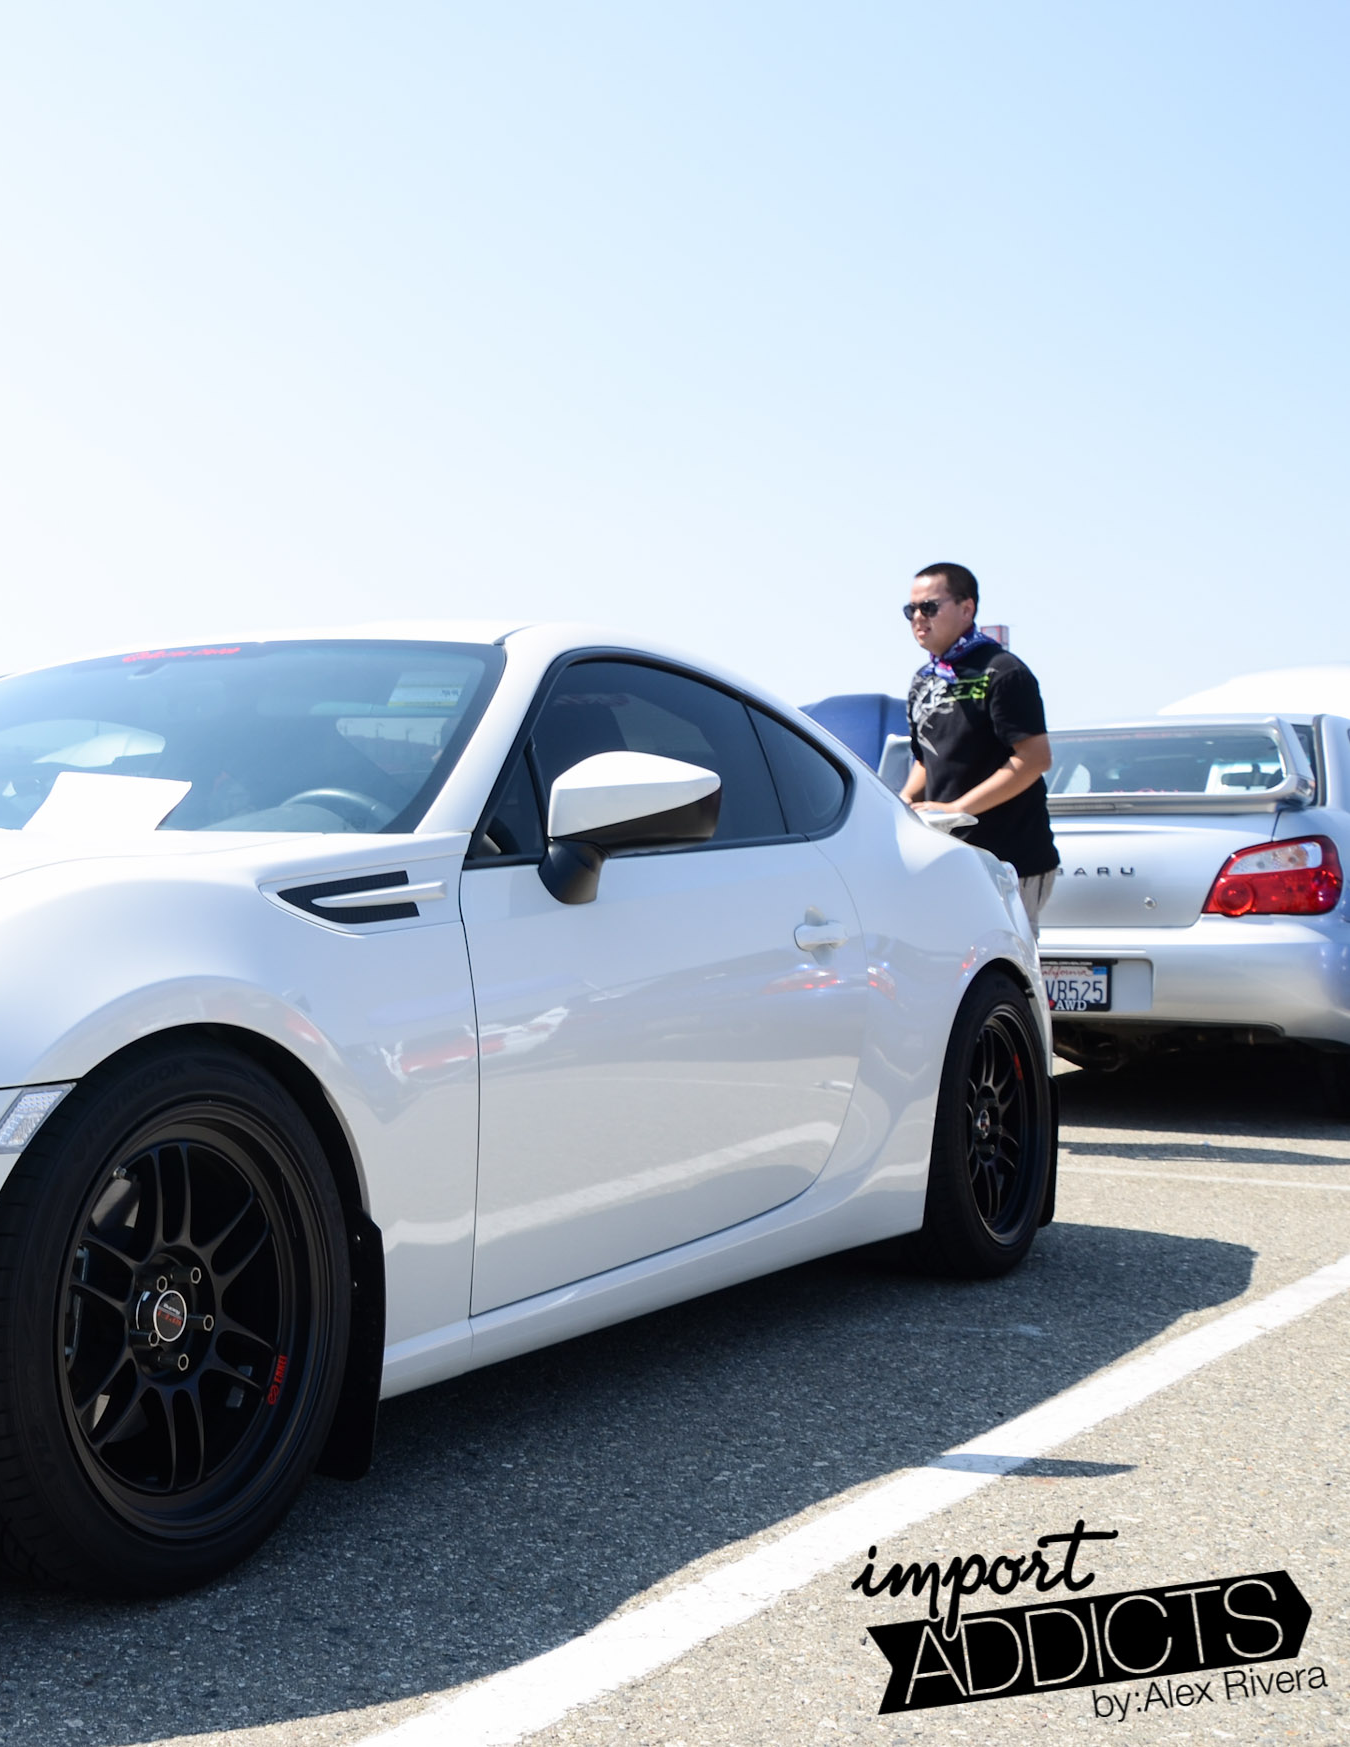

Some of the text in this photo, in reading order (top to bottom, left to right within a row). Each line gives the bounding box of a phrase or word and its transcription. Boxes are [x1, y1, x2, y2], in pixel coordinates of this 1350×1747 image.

[1055, 867, 1134, 876] BARU
[1041, 966, 1092, 979] alifornia
[1045, 980, 1104, 1003] VB525
[1055, 1000, 1087, 1011] AWD
